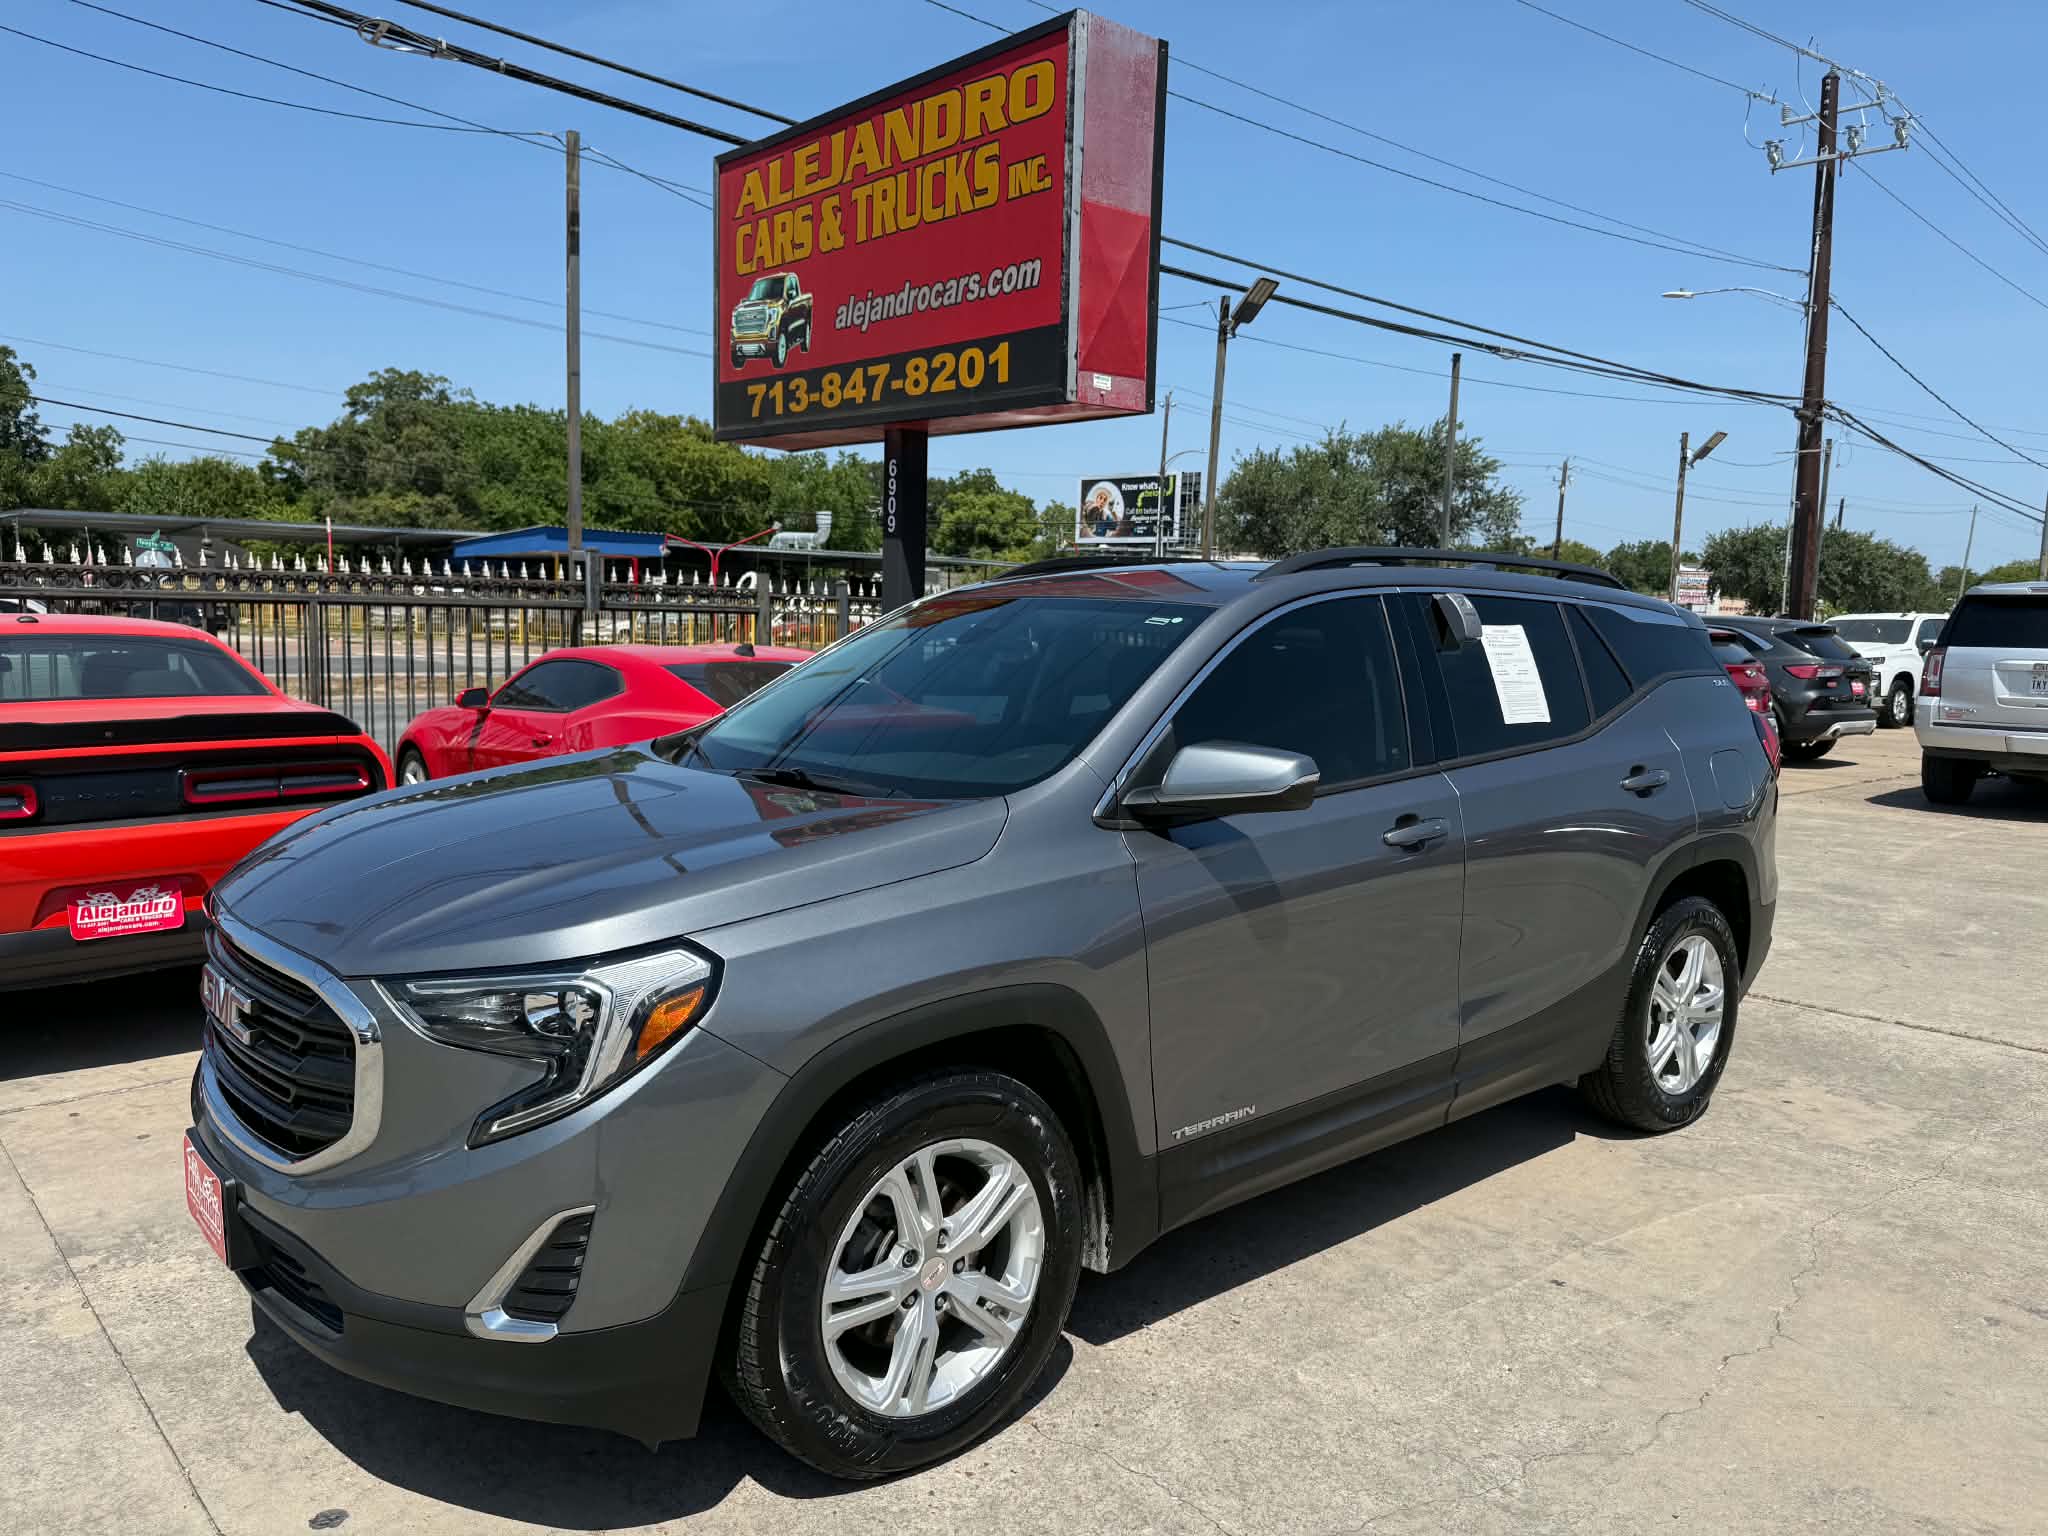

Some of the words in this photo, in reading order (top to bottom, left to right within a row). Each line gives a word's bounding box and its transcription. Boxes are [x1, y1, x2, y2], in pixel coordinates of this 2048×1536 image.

[735, 60, 1056, 219] ALEJANDRO
[735, 213, 813, 276] CARS
[818, 193, 846, 253] &
[851, 141, 1001, 243] TRUCKS
[1007, 155, 1053, 200] INC.
[834, 257, 1042, 332] alejandrocars.com
[747, 342, 1010, 418] 713-847-8201
[887, 458, 897, 533] 6909
[78, 899, 175, 922] Alejandro
[200, 963, 253, 1047] GMC
[1171, 1104, 1256, 1140] TERRAIN
